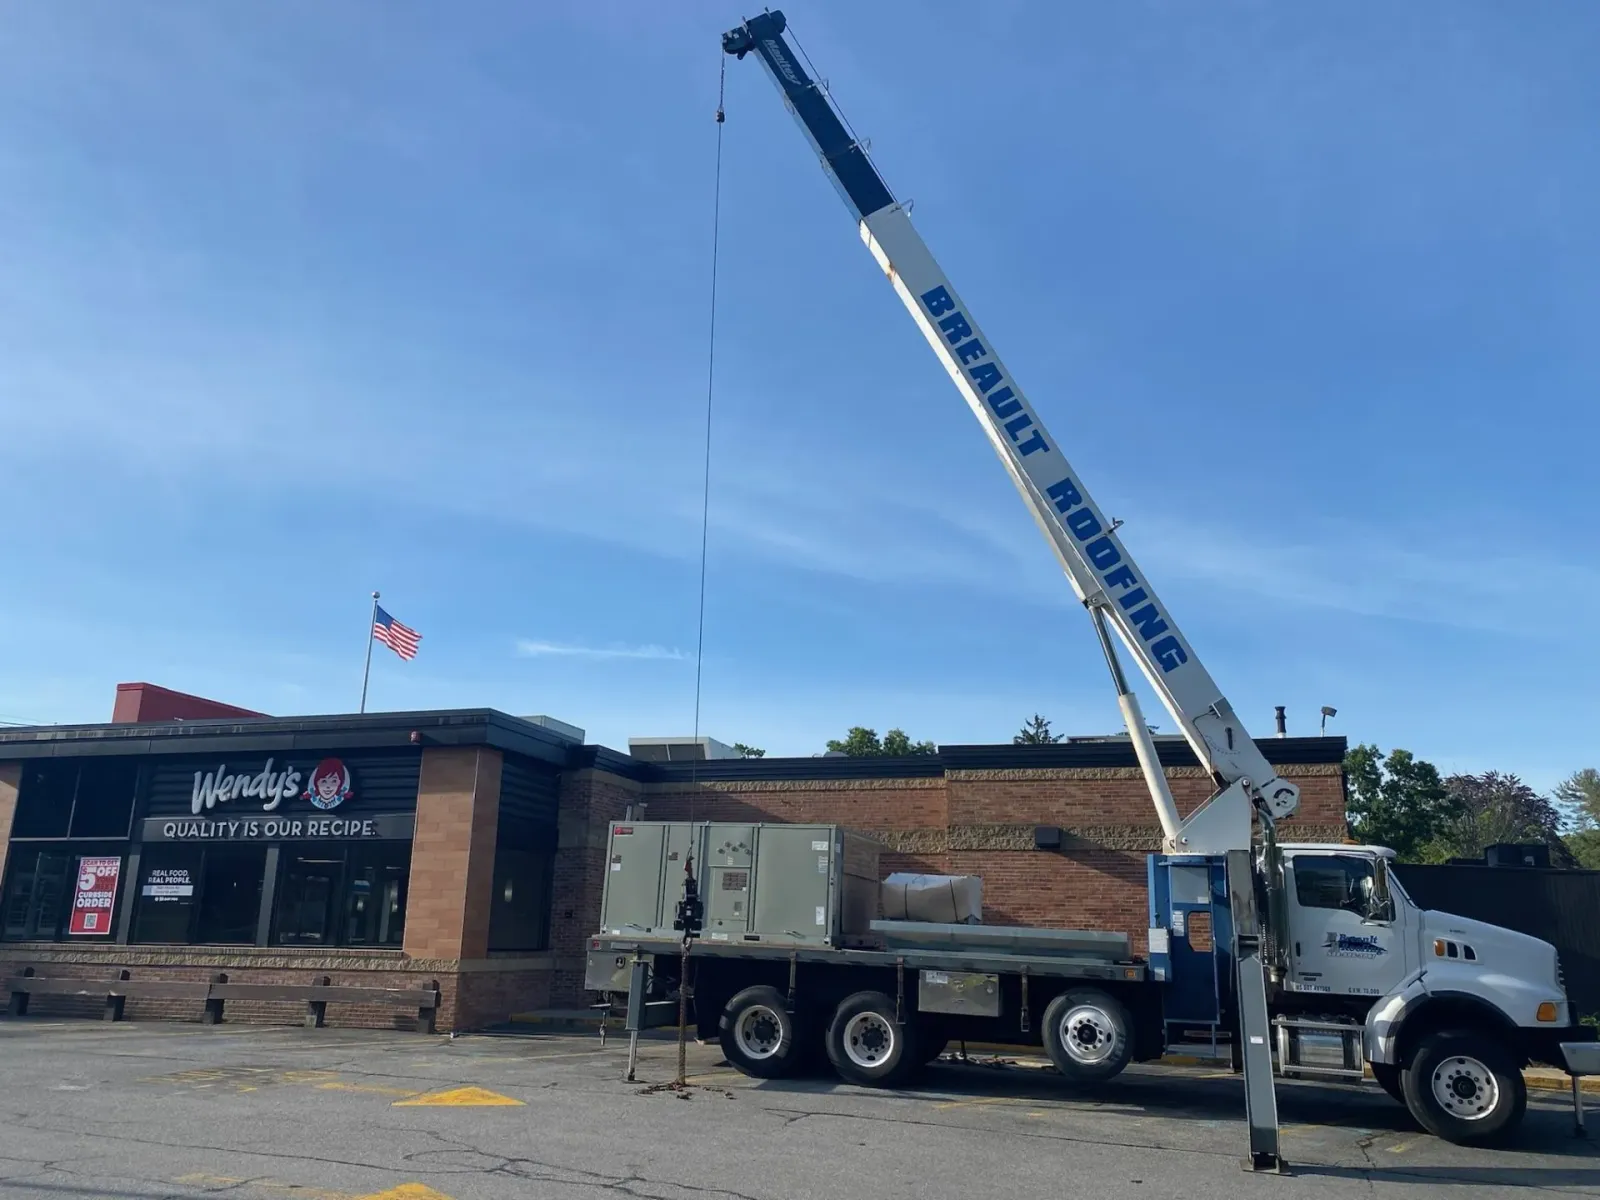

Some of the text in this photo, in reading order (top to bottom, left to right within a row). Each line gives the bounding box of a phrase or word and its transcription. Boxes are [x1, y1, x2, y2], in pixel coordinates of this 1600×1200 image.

[920, 285, 1188, 673] BREAULT ROOFING
[191, 757, 301, 814] Wendy's
[163, 820, 376, 838] QUALITY IS OUR RECIPE.
[97, 866, 117, 877] OFF
[76, 898, 111, 908] ORDER
